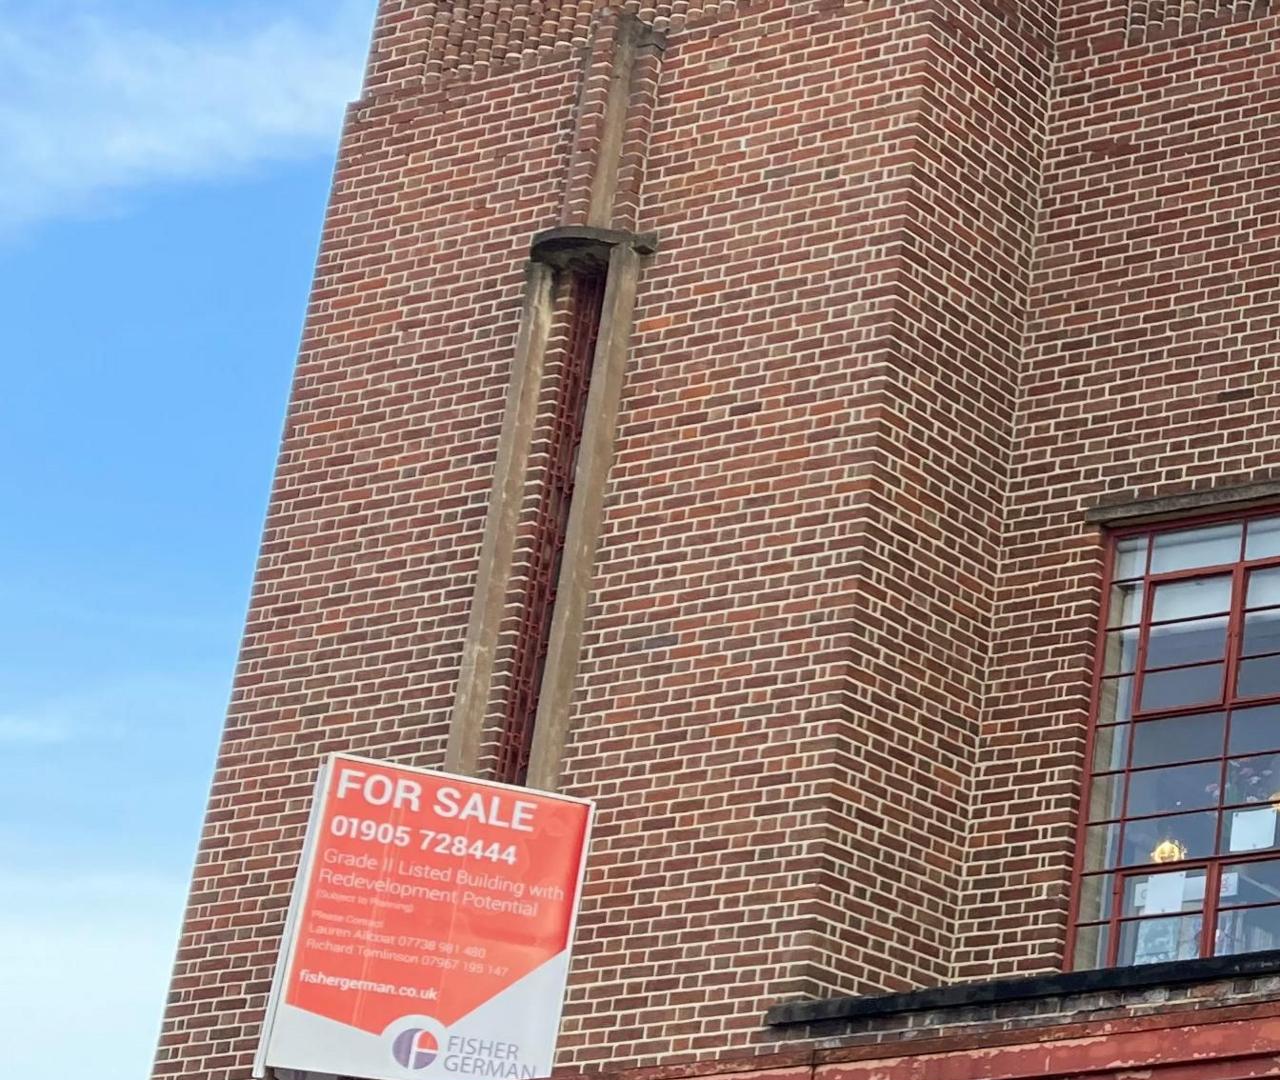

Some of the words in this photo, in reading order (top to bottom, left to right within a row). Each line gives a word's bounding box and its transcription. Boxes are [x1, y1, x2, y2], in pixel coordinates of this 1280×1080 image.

[336, 768, 421, 812] FOR
[433, 787, 538, 832] SALE
[331, 815, 411, 846] 01905
[419, 829, 517, 865] 728444
[324, 848, 378, 869] Grade
[398, 861, 452, 882] Listed
[456, 870, 525, 897] Building
[529, 884, 565, 900] with
[319, 868, 458, 904] Redevelopment
[463, 891, 538, 917] Potential
[309, 924, 351, 938] Lauren
[306, 938, 354, 953] Richard
[358, 944, 418, 964] Tomlinson
[299, 968, 438, 1000] fishergerman.co.uk
[447, 1035, 519, 1060] FISHER
[443, 1054, 537, 1080] GERMAN
